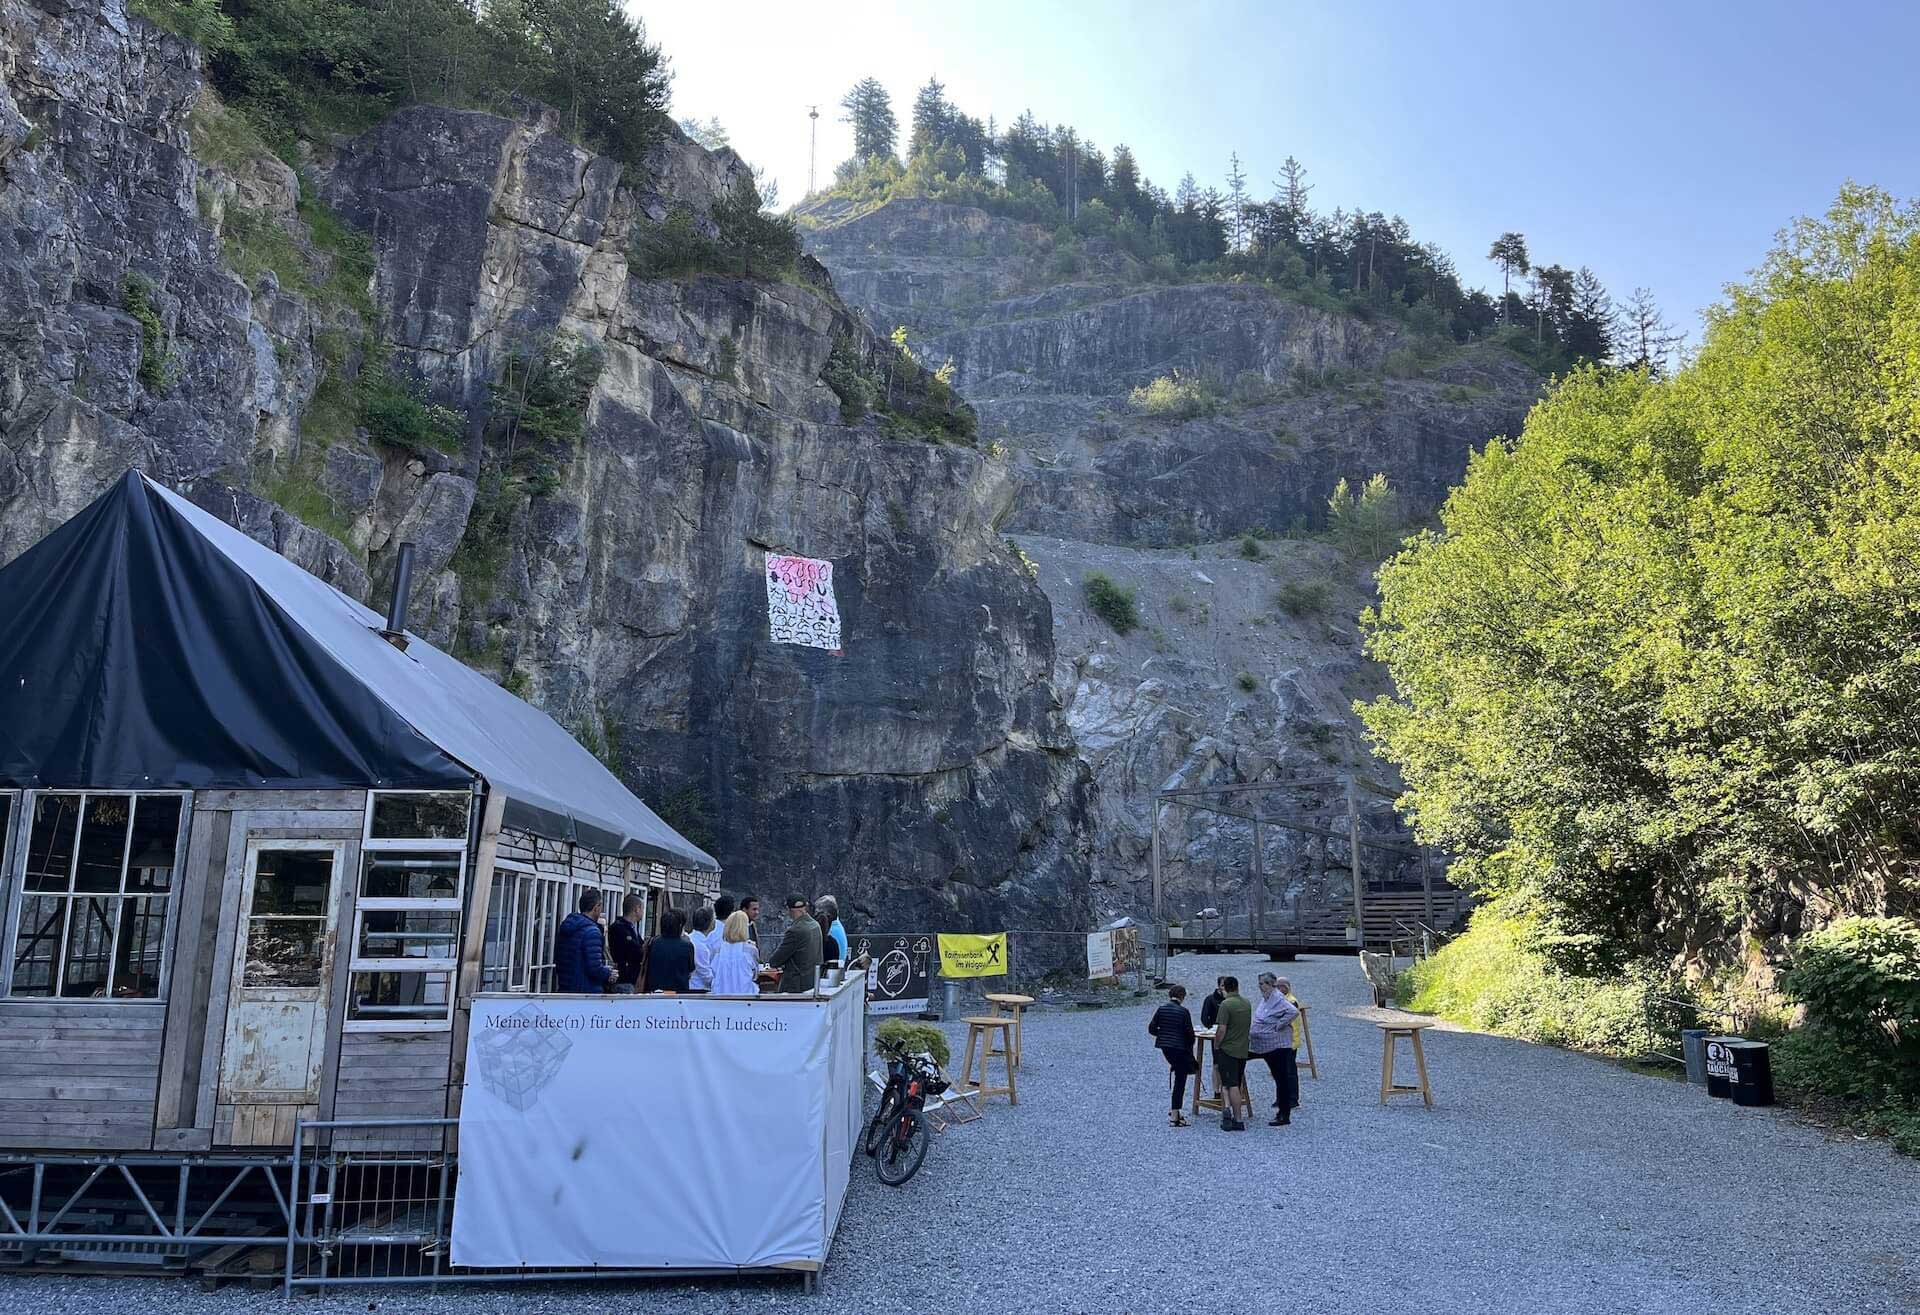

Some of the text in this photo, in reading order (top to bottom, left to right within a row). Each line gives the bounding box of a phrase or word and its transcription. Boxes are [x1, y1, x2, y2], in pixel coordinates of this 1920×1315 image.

[485, 1014, 788, 1032] Meine Idee(n) für den Steinbruch Ludesch:
